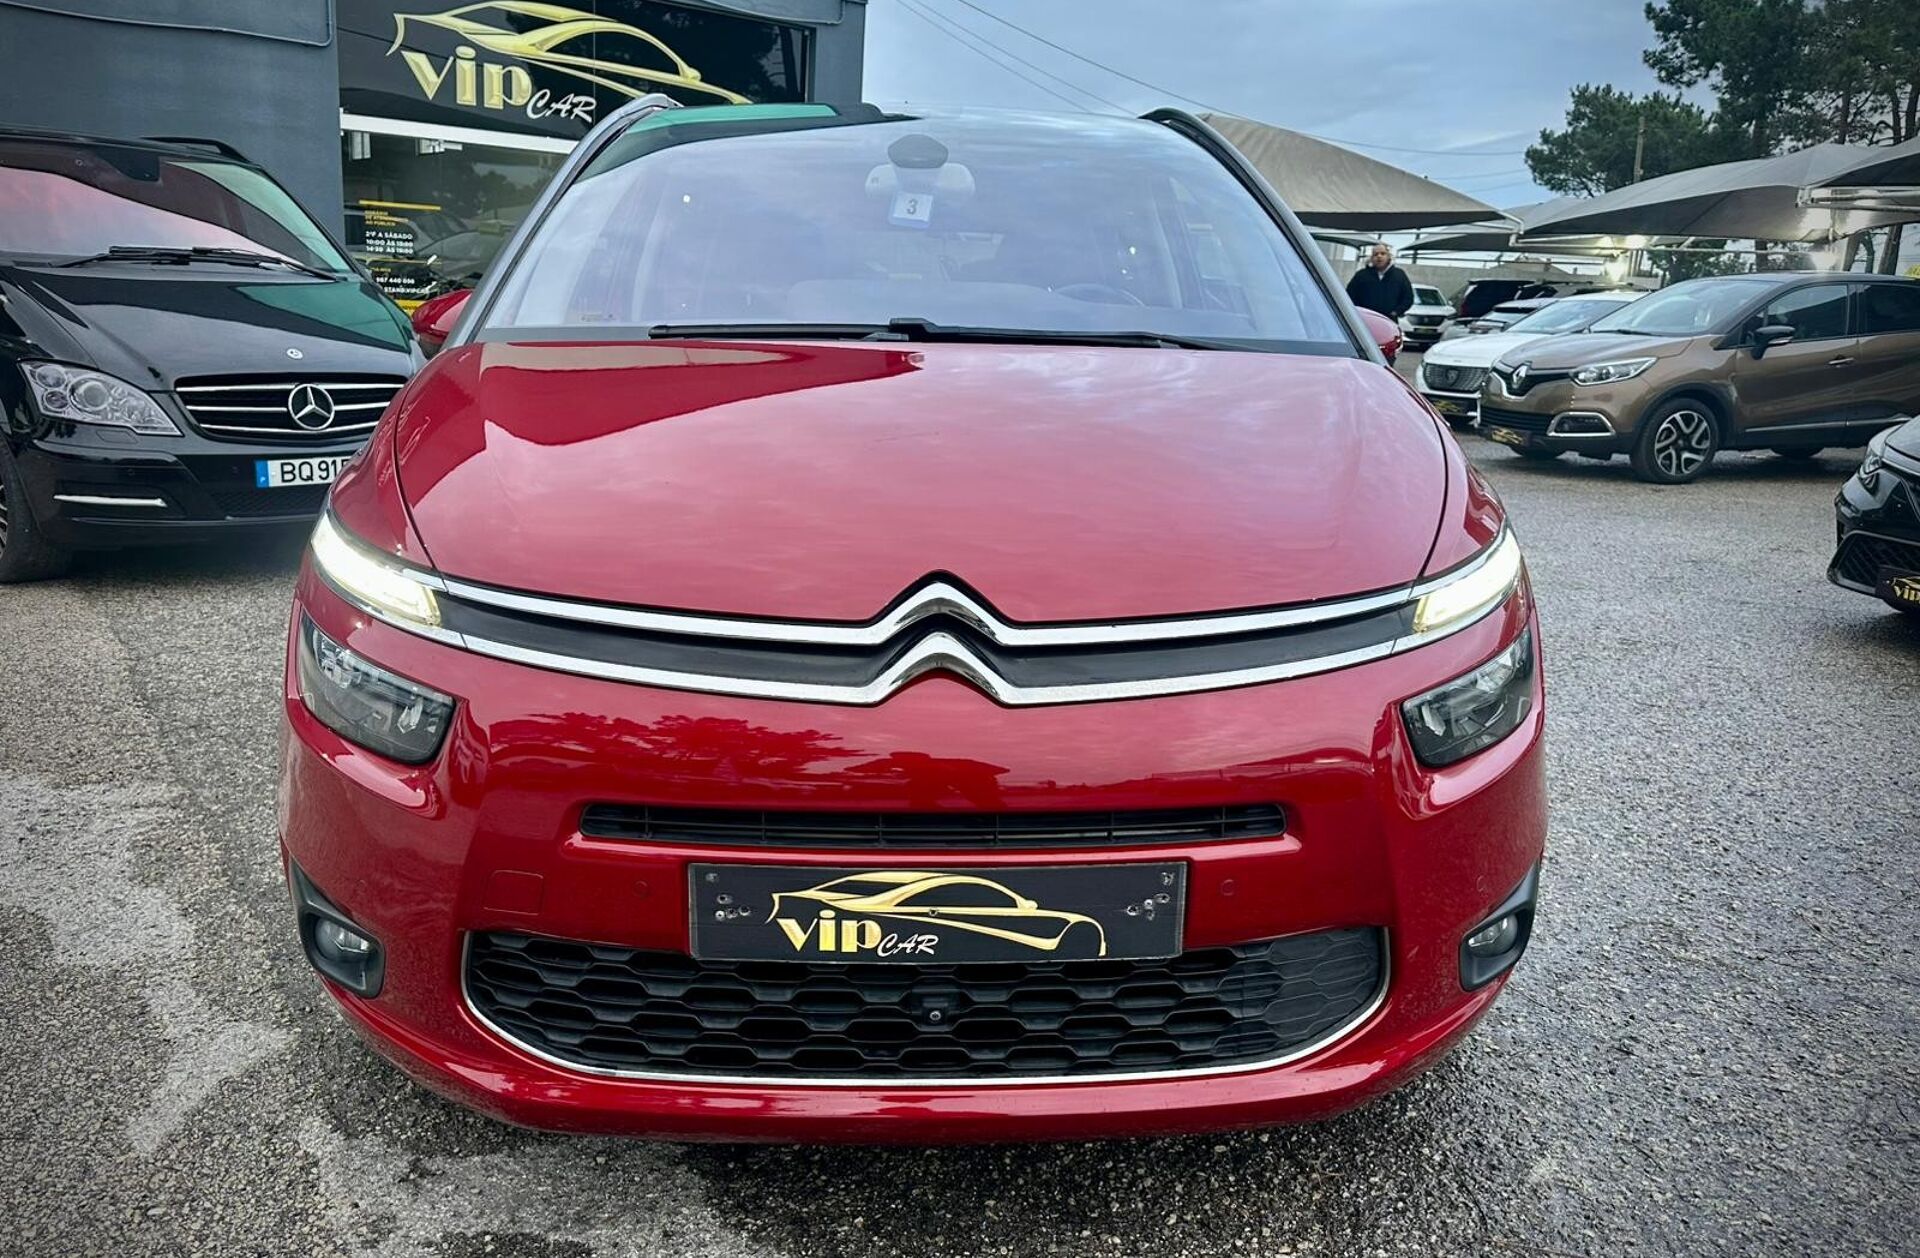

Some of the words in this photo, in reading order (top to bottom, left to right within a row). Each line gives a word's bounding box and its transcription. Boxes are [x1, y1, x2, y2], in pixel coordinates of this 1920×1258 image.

[526, 89, 597, 123] CAR
[906, 199, 919, 215] 3
[877, 933, 939, 957] CAR
